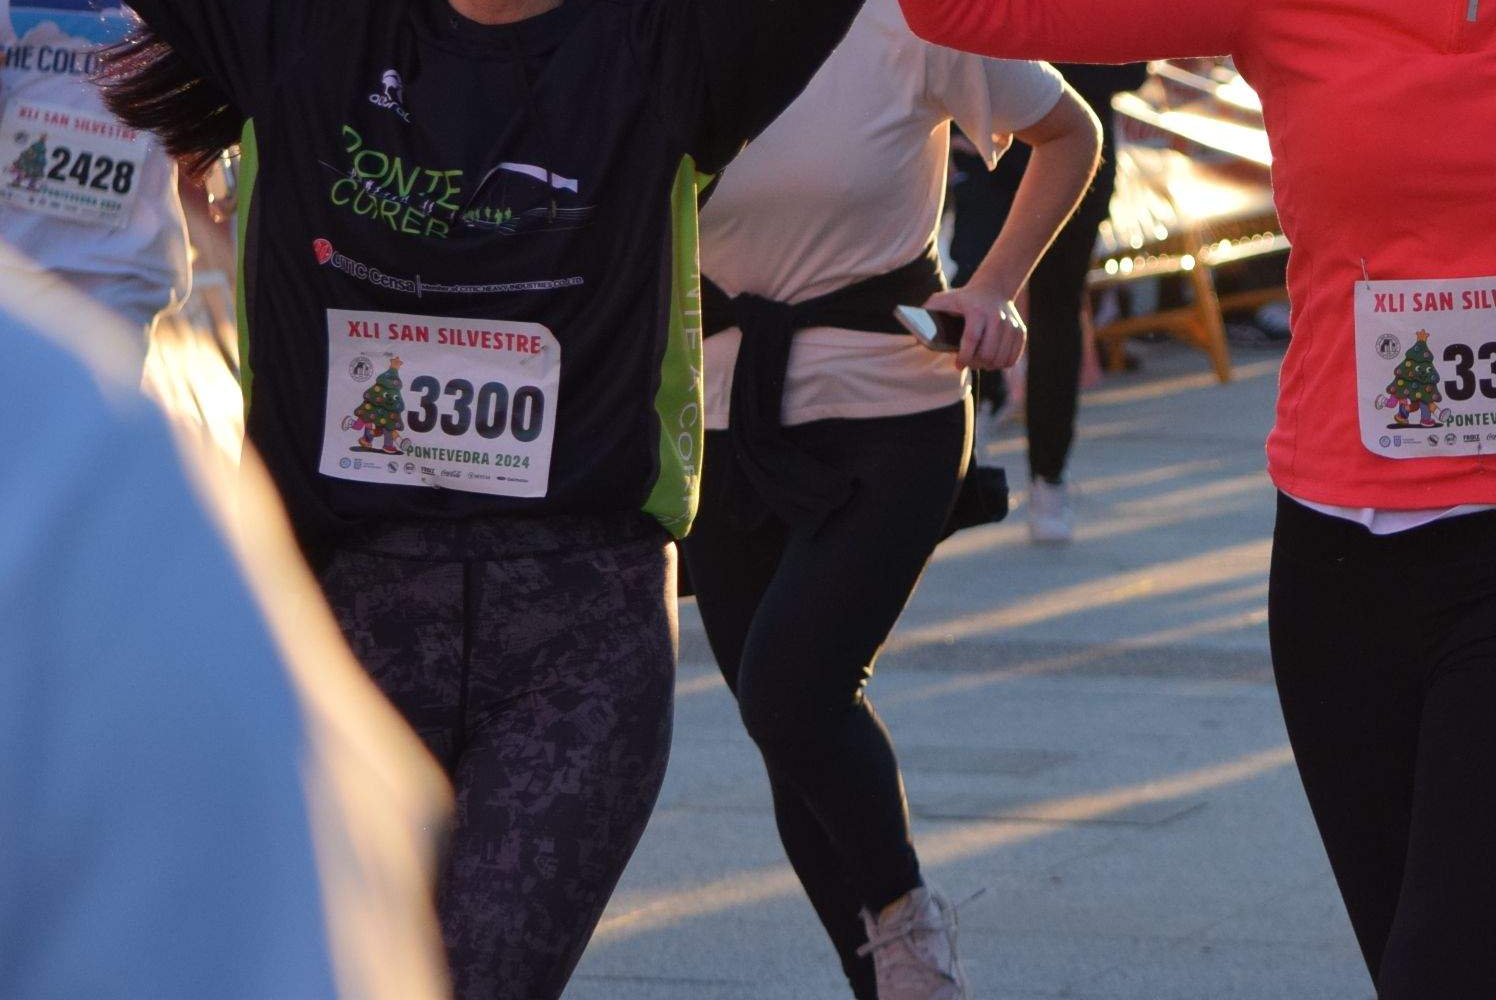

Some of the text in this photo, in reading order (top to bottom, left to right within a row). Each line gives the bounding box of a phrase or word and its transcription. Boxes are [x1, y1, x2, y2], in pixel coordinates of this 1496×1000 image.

[1, 45, 33, 71] HE
[48, 145, 135, 195] 2428
[1374, 293, 1404, 312] XLI
[1413, 291, 1453, 312] SAN
[348, 320, 542, 354] XLI SAN SILVESTRE
[407, 375, 545, 442] 3300
[407, 444, 530, 469] PONTEVEDRA 2024
